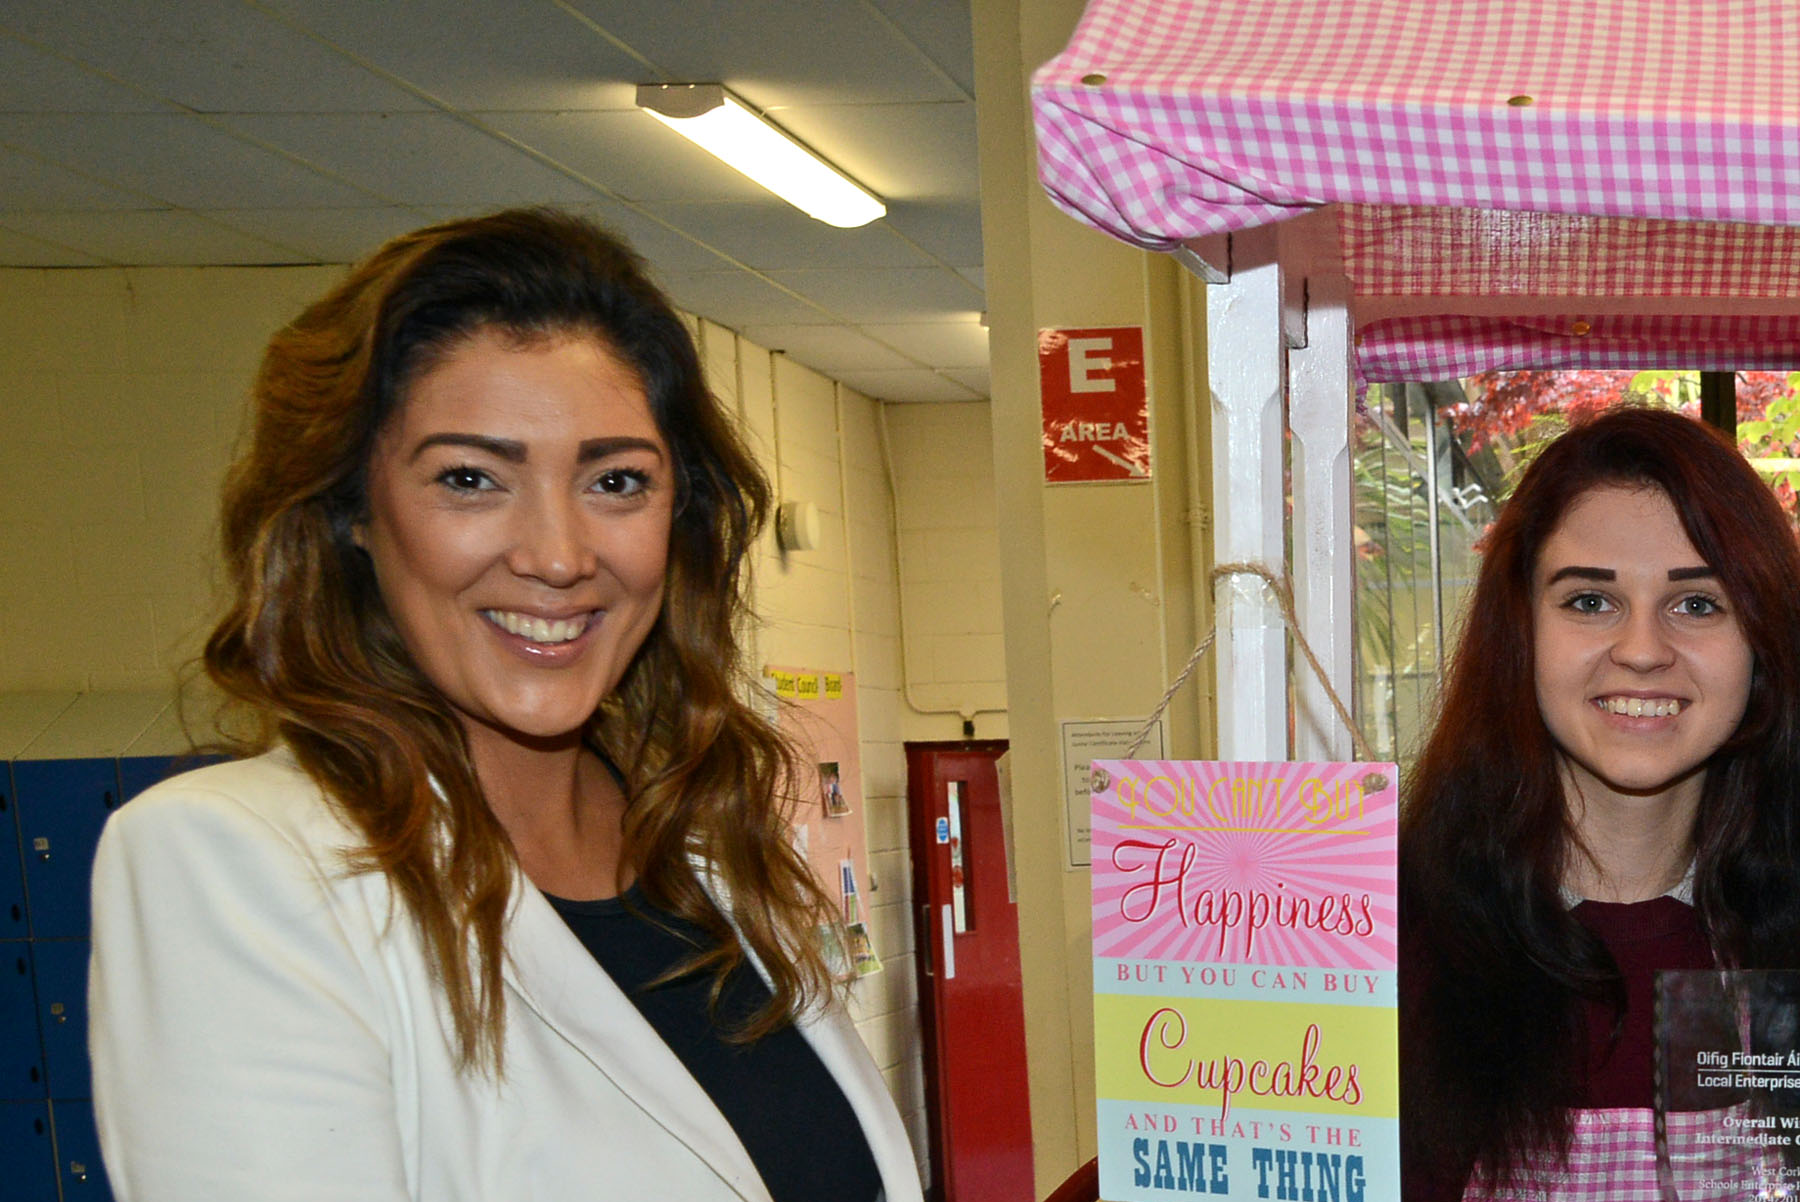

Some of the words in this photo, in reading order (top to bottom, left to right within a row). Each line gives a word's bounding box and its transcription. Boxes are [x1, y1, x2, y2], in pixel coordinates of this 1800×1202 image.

[1068, 337, 1116, 393] E
[1060, 422, 1129, 442] AREA
[1117, 776, 1195, 821] YOU
[1208, 777, 1285, 822] CAN'T
[1300, 778, 1366, 824] BUY
[1112, 838, 1374, 958] Happiness
[1117, 964, 1168, 983] BUT
[1182, 967, 1236, 986] YOU
[1252, 970, 1308, 990] CAN
[1324, 974, 1379, 994] BUY
[1140, 1008, 1363, 1120] Cupcakes
[1697, 1051, 1728, 1068] Oifig
[1732, 1052, 1784, 1067] Fiontair
[1697, 1074, 1732, 1087] Local
[1125, 1113, 1177, 1133] AND
[1192, 1117, 1292, 1142] THAT'S
[1306, 1126, 1362, 1147] THE
[1723, 1117, 1776, 1129] Overall
[1695, 1133, 1791, 1146] Intermediate
[1133, 1137, 1229, 1195] SAME
[1751, 1166, 1776, 1176] West
[1699, 1179, 1738, 1190] Schools
